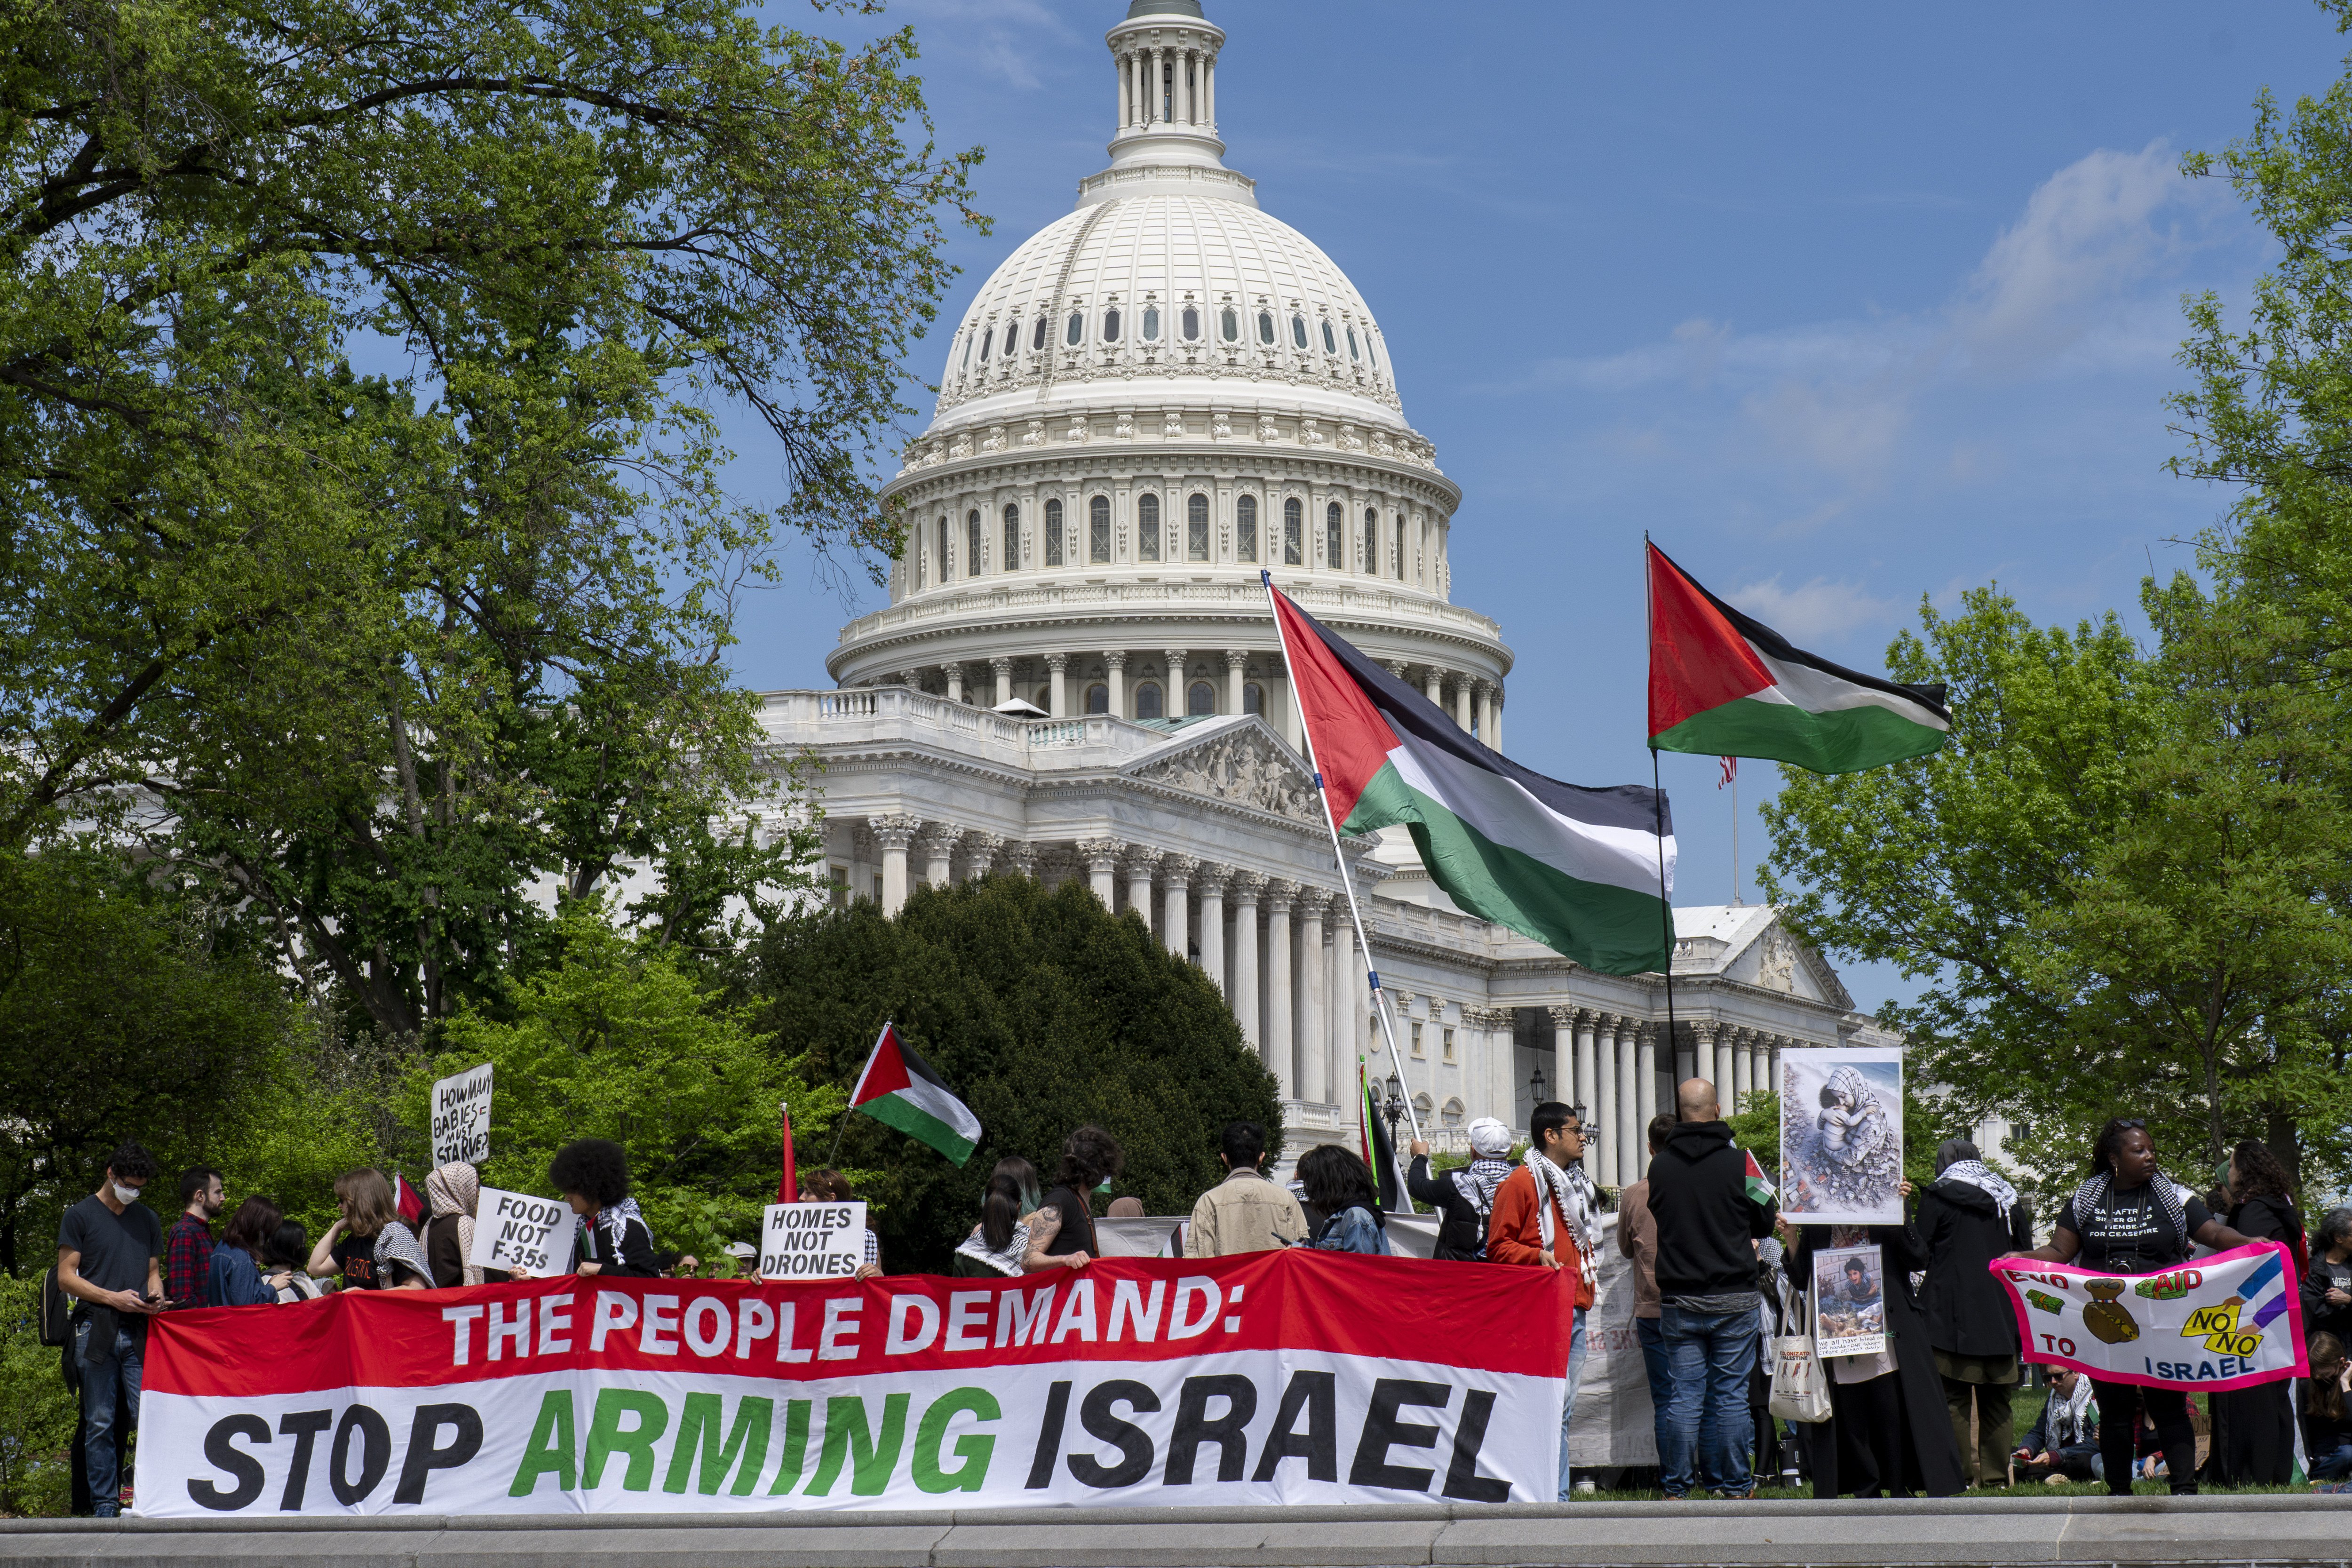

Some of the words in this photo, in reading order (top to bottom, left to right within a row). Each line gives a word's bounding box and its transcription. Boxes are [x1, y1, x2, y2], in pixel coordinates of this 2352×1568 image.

[440, 1088, 468, 1112] HOW
[468, 1072, 492, 1101] MANY
[434, 1102, 477, 1138] BABIES
[445, 1122, 474, 1144] MUST
[437, 1131, 488, 1164] STARVE?
[497, 1197, 561, 1226] FOOD
[772, 1209, 851, 1229] HOMES
[501, 1220, 551, 1246] NOT
[785, 1231, 833, 1251] NOT
[2108, 1227, 2159, 1237] CEASEFIRE
[763, 1253, 856, 1274] DRONES
[2155, 1270, 2203, 1292] AID
[442, 1293, 574, 1366] THE
[589, 1290, 864, 1363] PEOPLE
[885, 1275, 1245, 1355] DEMAND:
[2192, 1310, 2231, 1332] NO
[2215, 1333, 2257, 1355] NO
[2040, 1334, 2076, 1356] TO
[2145, 1357, 2256, 1380] ISRAEL
[188, 1403, 484, 1510] STOP
[509, 1387, 1001, 1497] ARMING
[1025, 1370, 1511, 1503] ISRAEL
